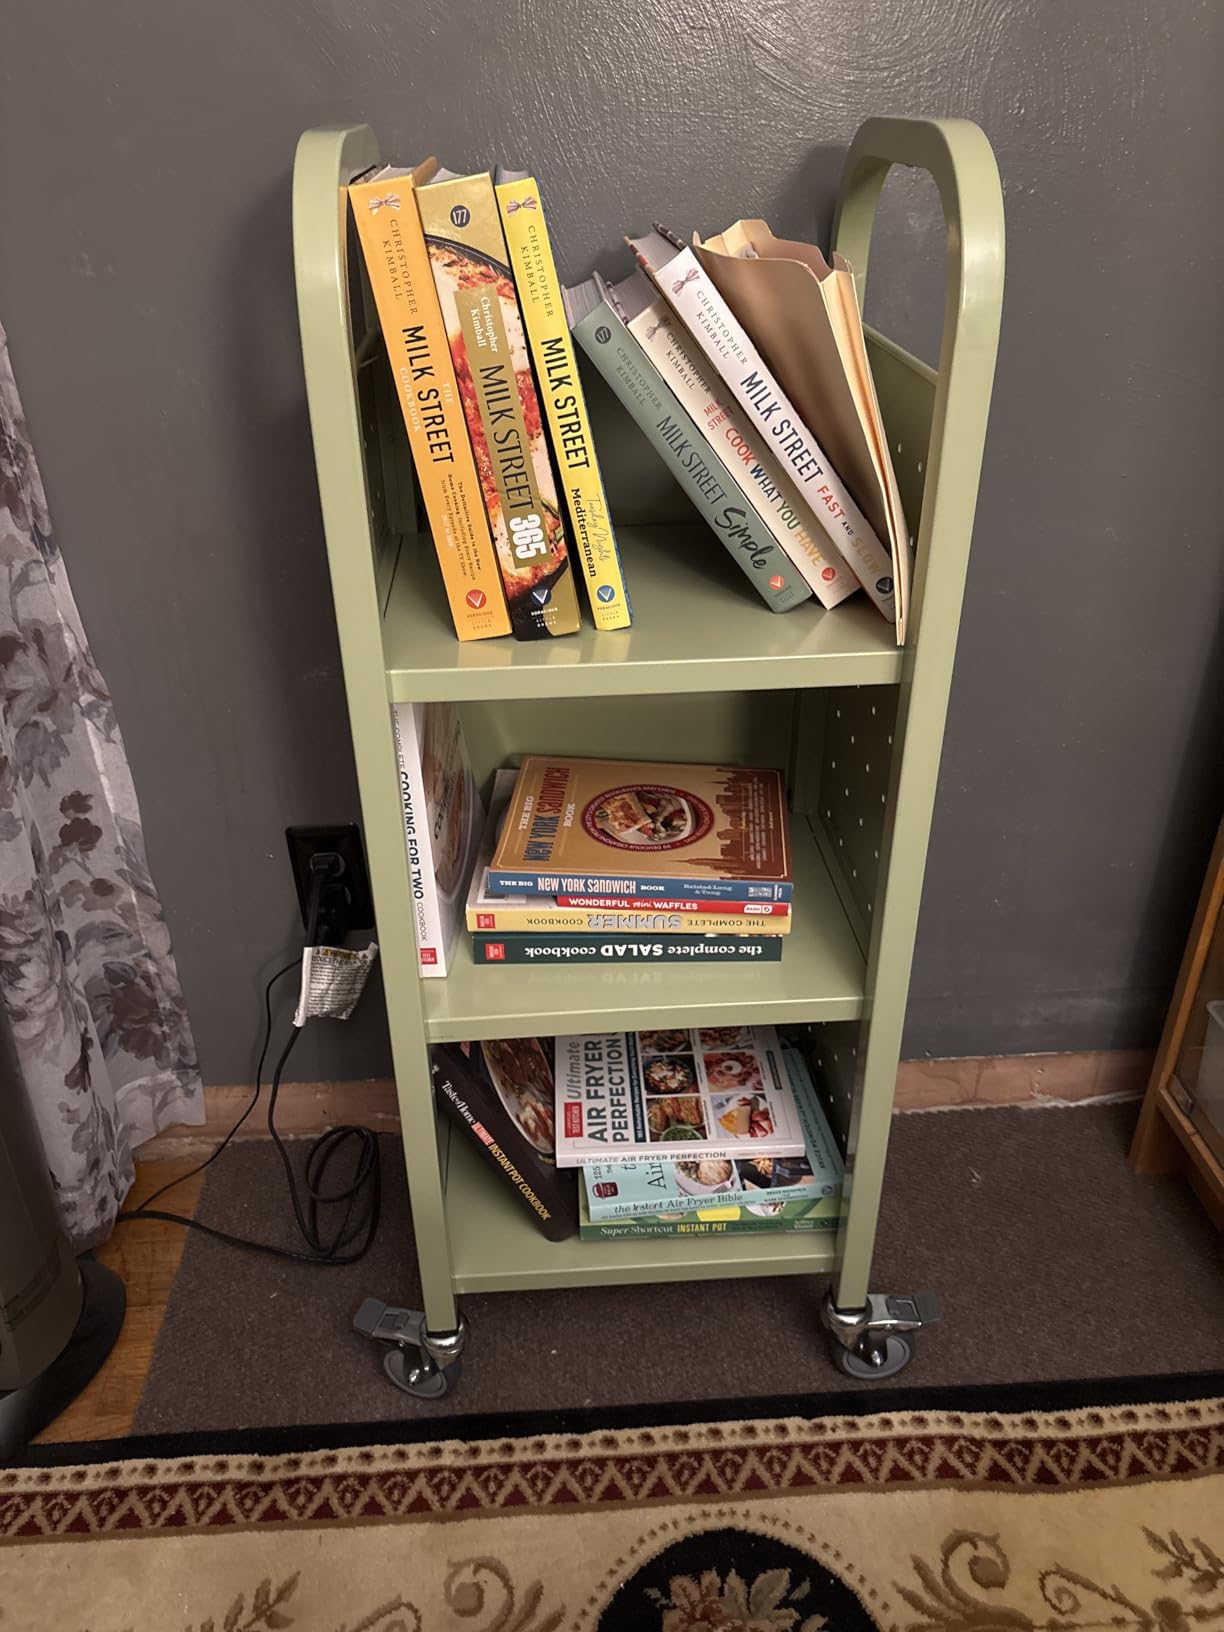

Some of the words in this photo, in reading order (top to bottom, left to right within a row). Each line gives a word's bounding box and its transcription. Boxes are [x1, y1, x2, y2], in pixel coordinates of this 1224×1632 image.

[383, 240, 402, 300] KIMBALL
[390, 219, 418, 315] CHRISTOPHER
[520, 245, 540, 304] KIMBALL
[527, 224, 554, 317] CHRISTOPHER
[470, 308, 486, 348] Kimball
[480, 296, 498, 353] Christopher
[696, 290, 748, 365] CHRISTOPHER
[696, 311, 730, 360] KIMBALL
[402, 325, 435, 381] MILK
[541, 336, 572, 391] MILK
[665, 350, 696, 391] KIMBALL
[666, 332, 711, 394] CHRISTOPHER
[400, 367, 422, 432] COOKBOOK
[442, 382, 454, 405] THE
[479, 364, 516, 426] MILK
[616, 347, 663, 409] CHRISTOPHER
[616, 366, 645, 406] KIMBALL
[417, 388, 455, 463] STREET
[703, 397, 722, 418] MILK
[707, 407, 734, 431] STREET
[554, 395, 590, 469] STREET
[493, 428, 535, 509] STREET
[656, 415, 692, 458] MILK
[681, 451, 728, 505] STREET
[740, 370, 782, 422] MILK
[771, 418, 824, 483] STREET
[816, 485, 846, 519] FAST
[841, 521, 855, 537] AND
[851, 536, 881, 574] SLOW
[725, 427, 758, 466] COOK
[750, 463, 784, 503] WHAT
[776, 500, 801, 530] YOU
[793, 525, 825, 567] HAVE
[509, 513, 547, 559] 365
[571, 487, 597, 578] Mediterranean
[714, 506, 775, 570] Simple
[400, 771, 416, 835] COOKING
[518, 811, 530, 832] THE
[522, 793, 535, 812] BIG
[563, 803, 576, 828] BOOK
[528, 814, 561, 839] YORK
[407, 838, 420, 866] FOR
[411, 868, 424, 900] TWO
[561, 878, 586, 893] YORK
[569, 898, 631, 908] WONDERFUL
[632, 900, 651, 909] mini
[652, 901, 698, 910] WAFFLES
[416, 901, 428, 941] COOKBOOK
[587, 913, 682, 929] SUMMER
[687, 919, 742, 927] COMPLETE
[524, 946, 597, 958] cookbook
[600, 944, 663, 957] SALAD
[667, 943, 736, 956] complete
[738, 945, 762, 956] the
[566, 1041, 582, 1099] Ultimate
[584, 1039, 606, 1100] FRYER
[606, 1038, 630, 1143] PERFECTION
[587, 1106, 608, 1143] AIR
[441, 1080, 460, 1102] Taste
[488, 1143, 514, 1175] INSTANT
[508, 1169, 525, 1185] POT
[518, 1183, 552, 1221] COOKBOOK
[576, 1157, 618, 1165] ULTIMATE
[638, 1154, 668, 1162] FRYER
[670, 1151, 727, 1160] PERFECTION
[614, 1204, 631, 1214] the
[632, 1201, 663, 1211] Instant
[666, 1199, 684, 1208] Air
[686, 1197, 715, 1208] Fryer
[717, 1194, 743, 1203] Bible
[600, 1226, 630, 1236] Super
[630, 1225, 673, 1234] Shortcut
[677, 1223, 709, 1233] INSTANT
[712, 1222, 727, 1231] POT
